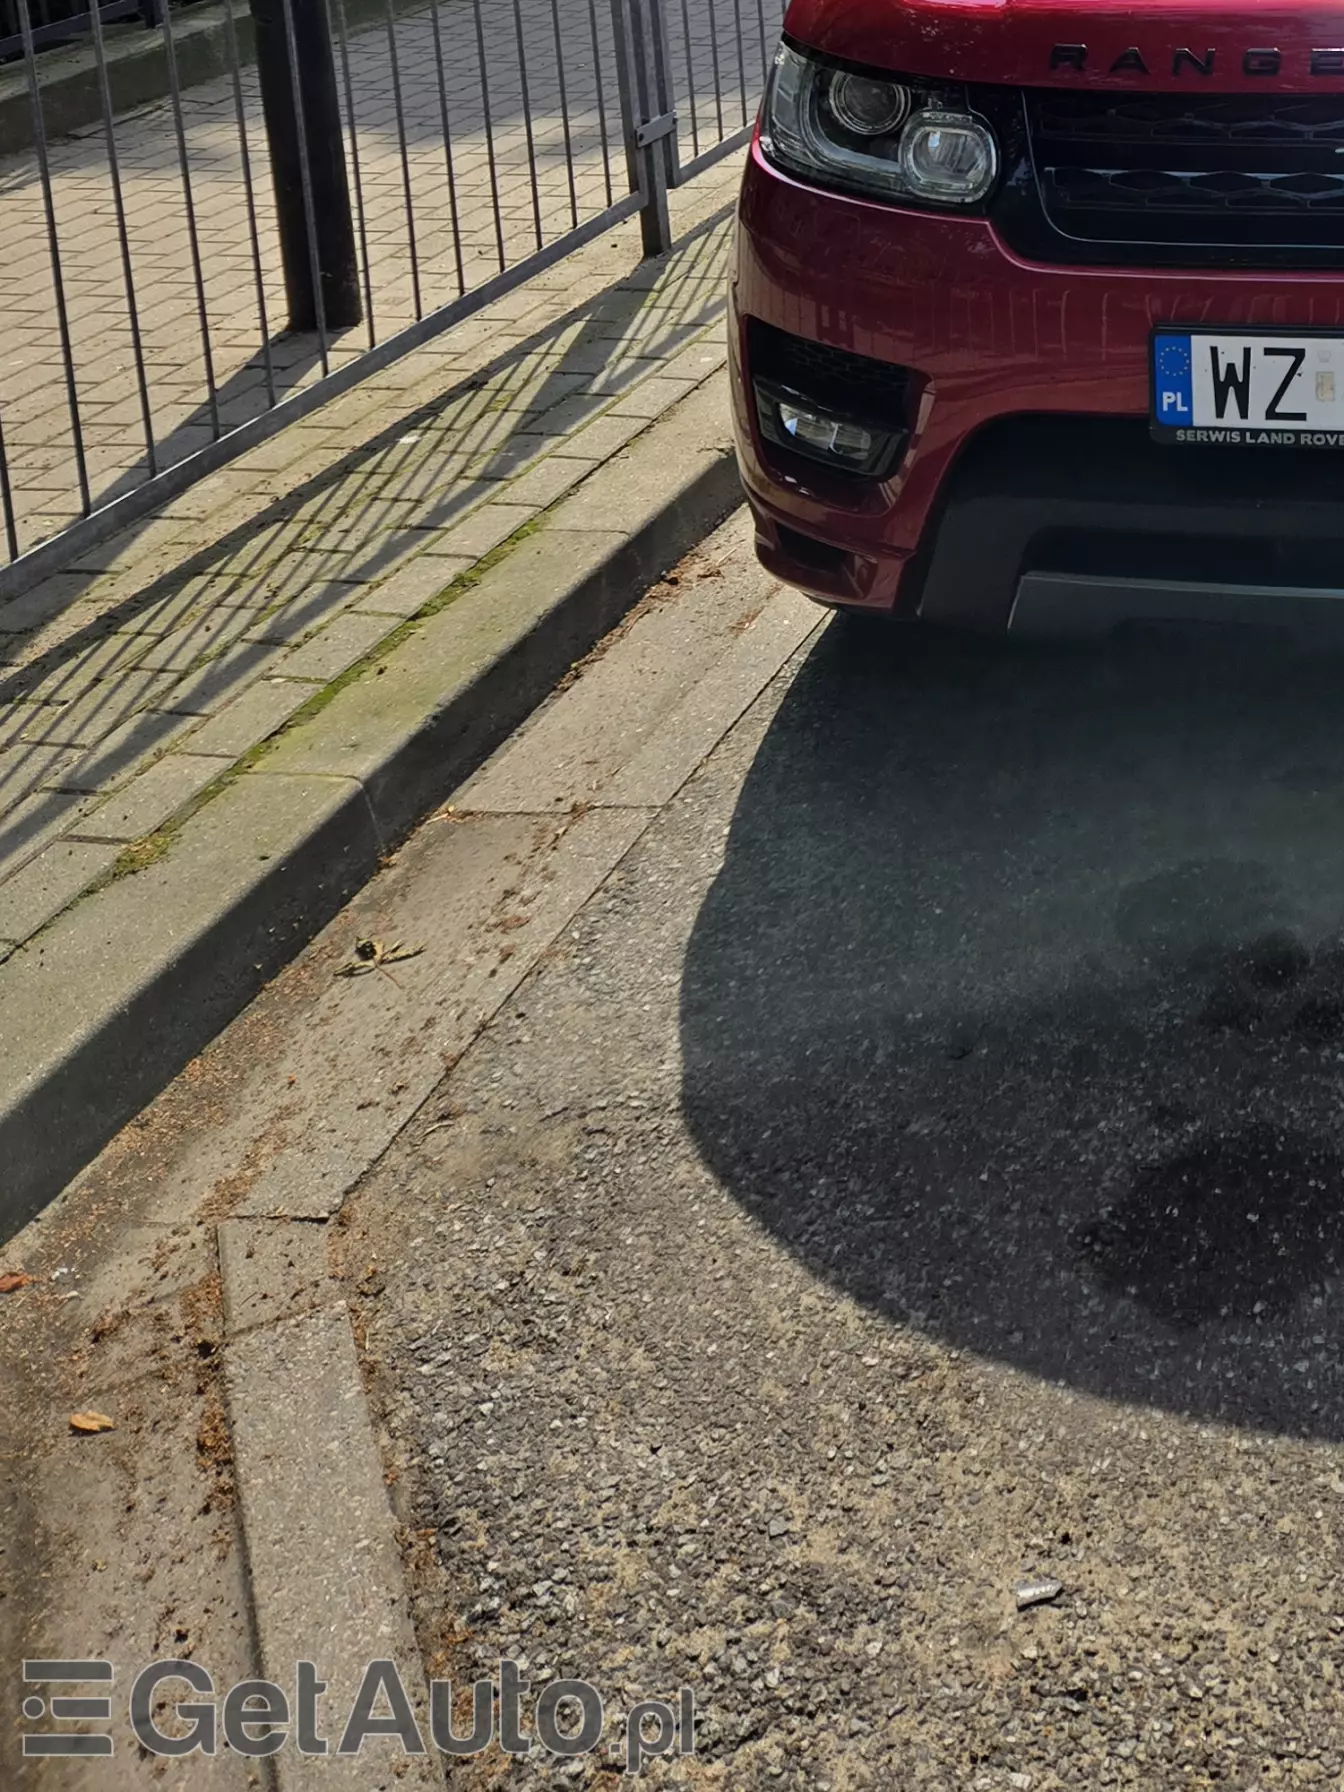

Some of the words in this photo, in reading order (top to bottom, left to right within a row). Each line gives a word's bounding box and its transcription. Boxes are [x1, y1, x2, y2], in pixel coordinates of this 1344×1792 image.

[1209, 345, 1308, 422] WZ
[1162, 391, 1188, 412] PL
[1176, 429, 1241, 444] SERWIS
[1245, 432, 1296, 445] LAND
